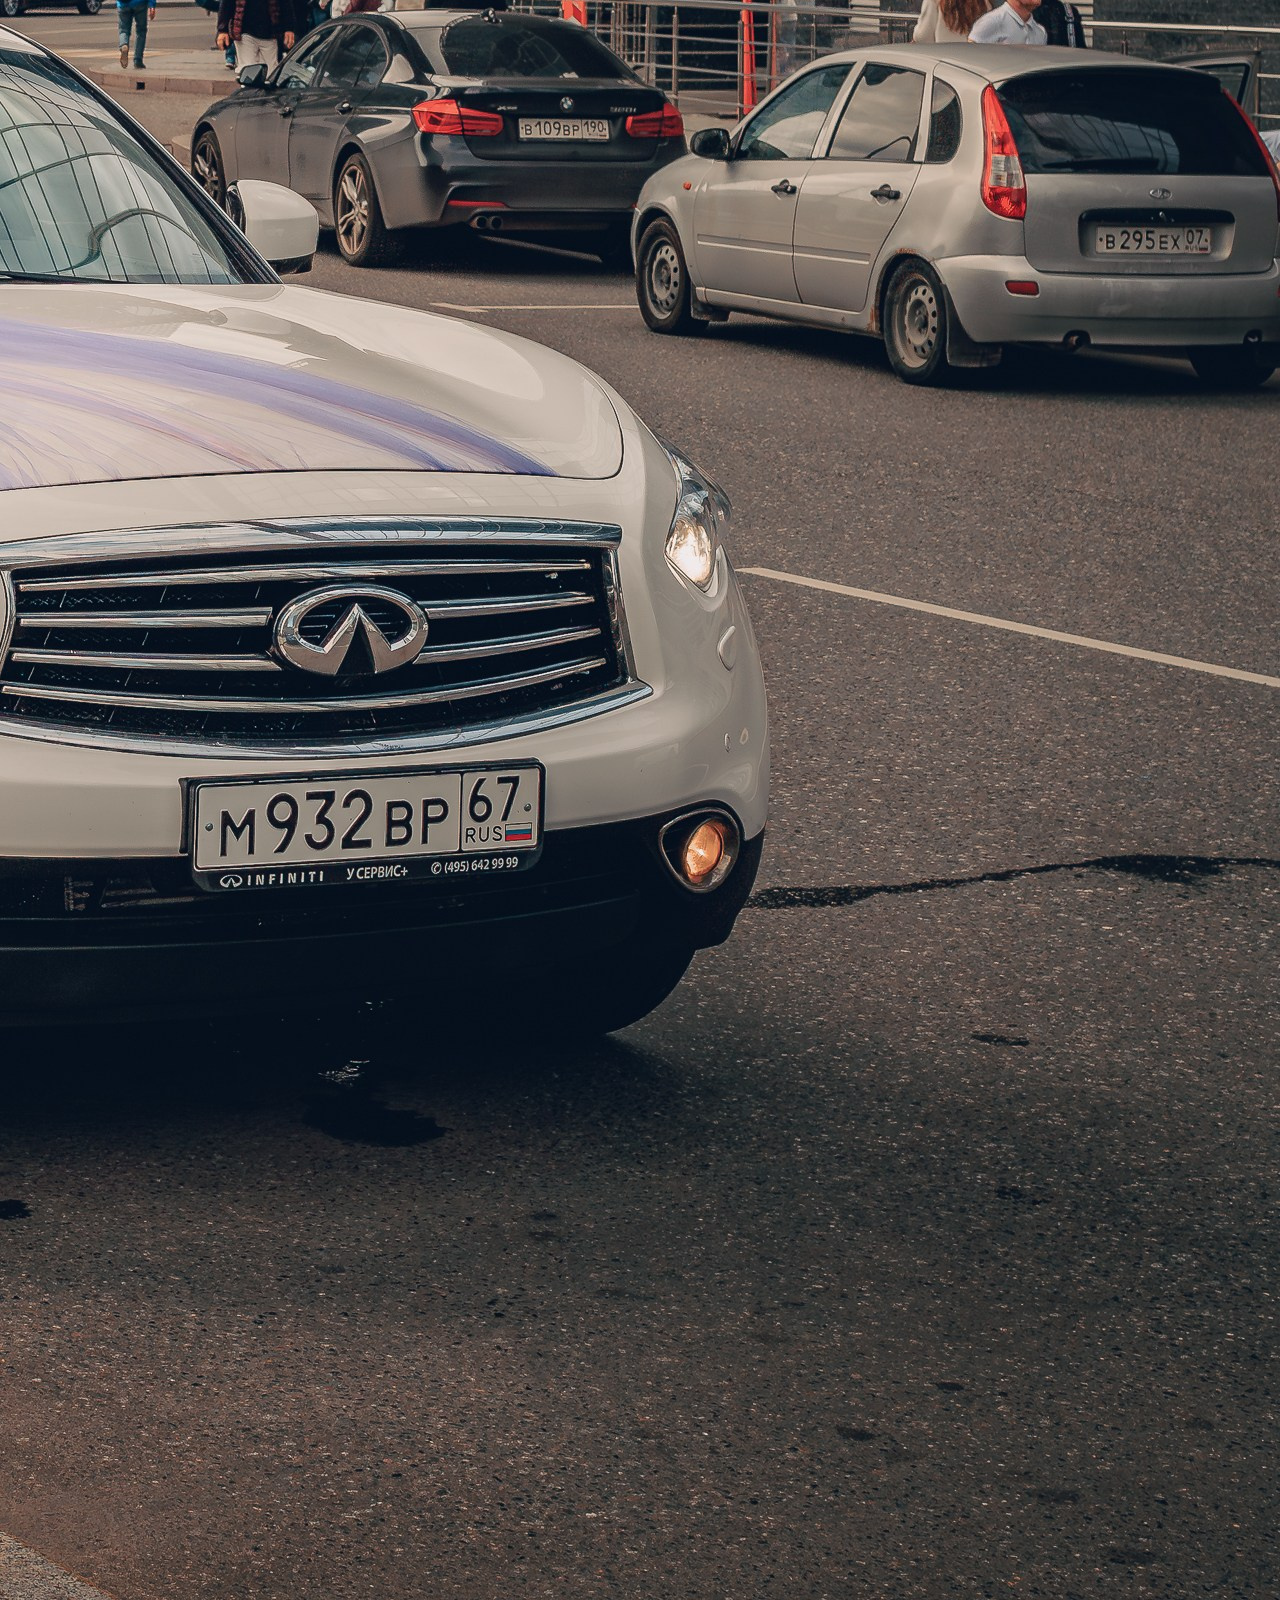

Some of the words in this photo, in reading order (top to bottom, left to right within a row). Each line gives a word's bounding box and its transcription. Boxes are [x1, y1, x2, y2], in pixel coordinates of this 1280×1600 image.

[584, 120, 604, 133] 190
[1186, 229, 1204, 245] 07
[467, 775, 520, 823] 67
[465, 825, 503, 844] RUS
[444, 860, 469, 874] (495)
[471, 859, 490, 871] 642
[492, 857, 504, 869] 99
[506, 856, 519, 868] 99
[247, 870, 324, 886] INFINITI
